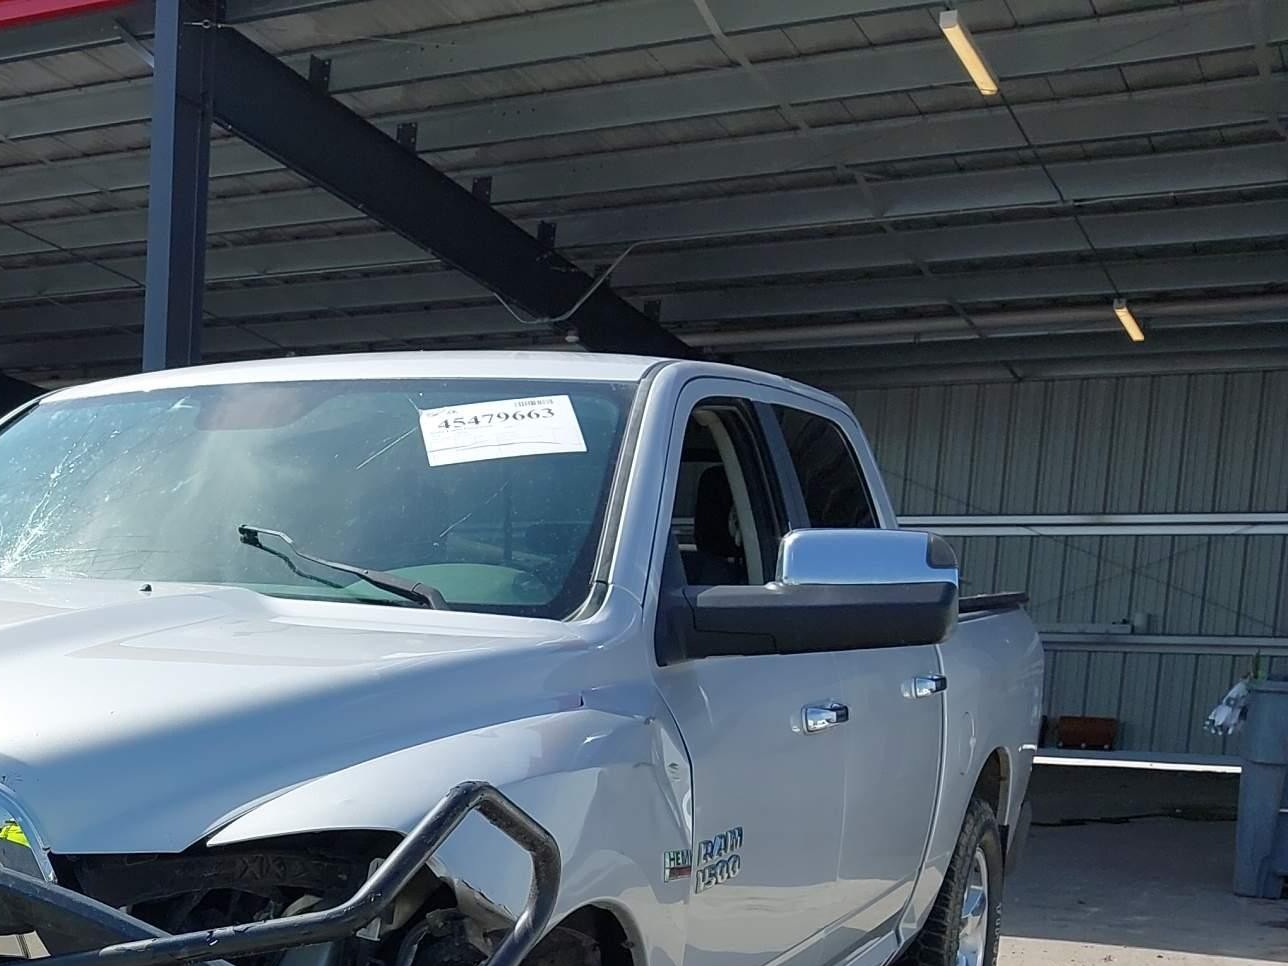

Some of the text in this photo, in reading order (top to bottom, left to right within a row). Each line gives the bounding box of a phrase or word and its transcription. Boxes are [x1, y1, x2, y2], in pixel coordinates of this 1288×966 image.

[437, 407, 555, 429] 45479663
[698, 826, 743, 865] RAM
[696, 855, 741, 893] 1500
